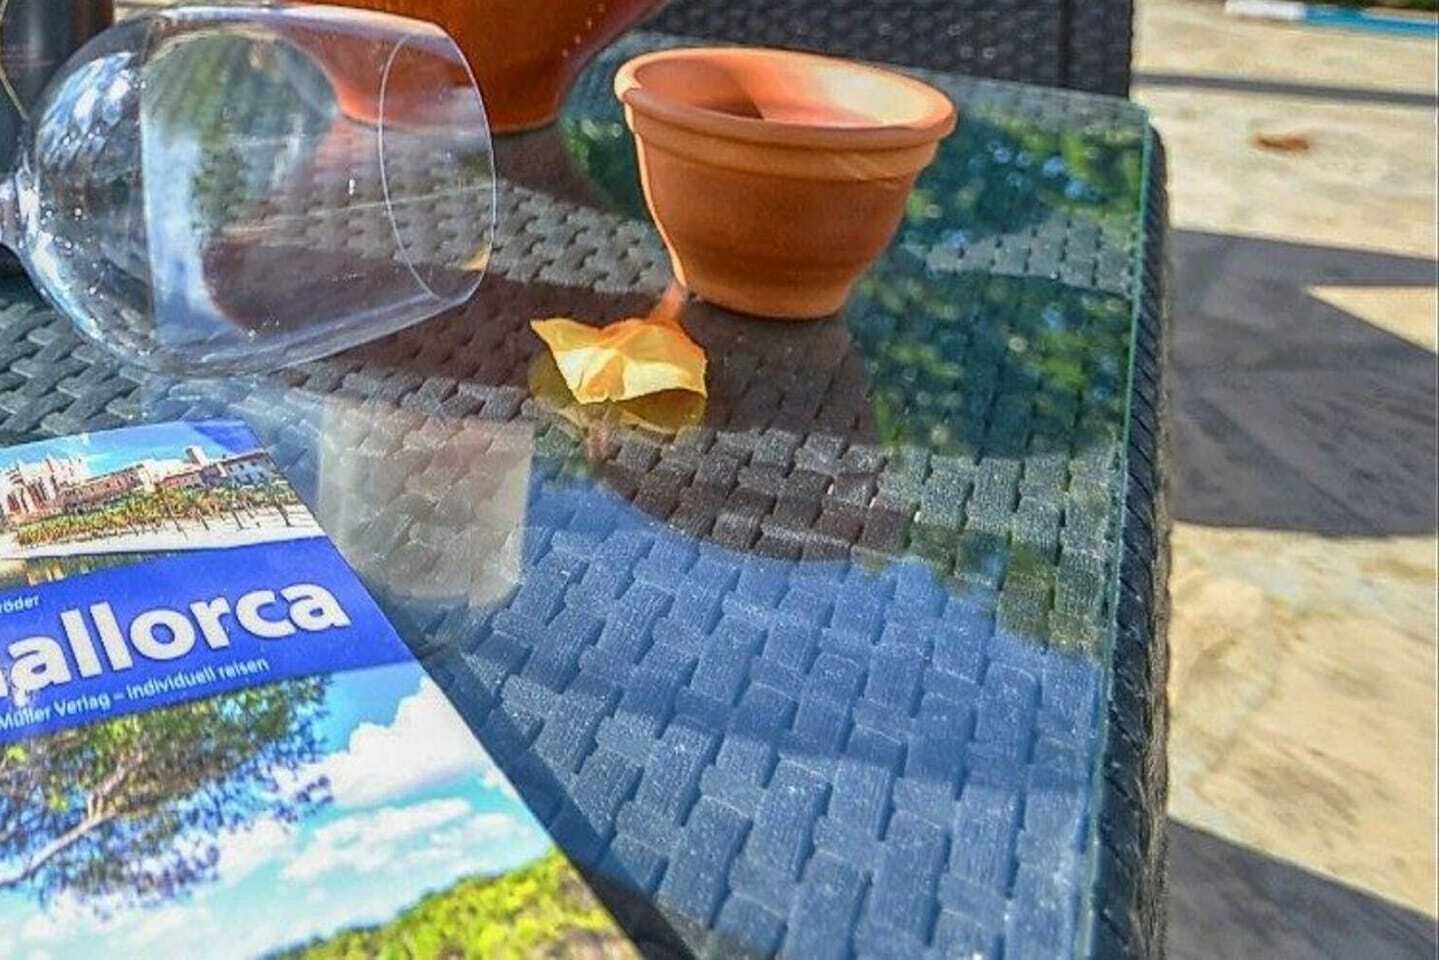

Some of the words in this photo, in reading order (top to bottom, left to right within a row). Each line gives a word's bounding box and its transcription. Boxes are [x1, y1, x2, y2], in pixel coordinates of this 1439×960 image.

[53, 692, 111, 715] Verlag
[126, 666, 216, 701] individuell
[218, 657, 270, 679] reisen
